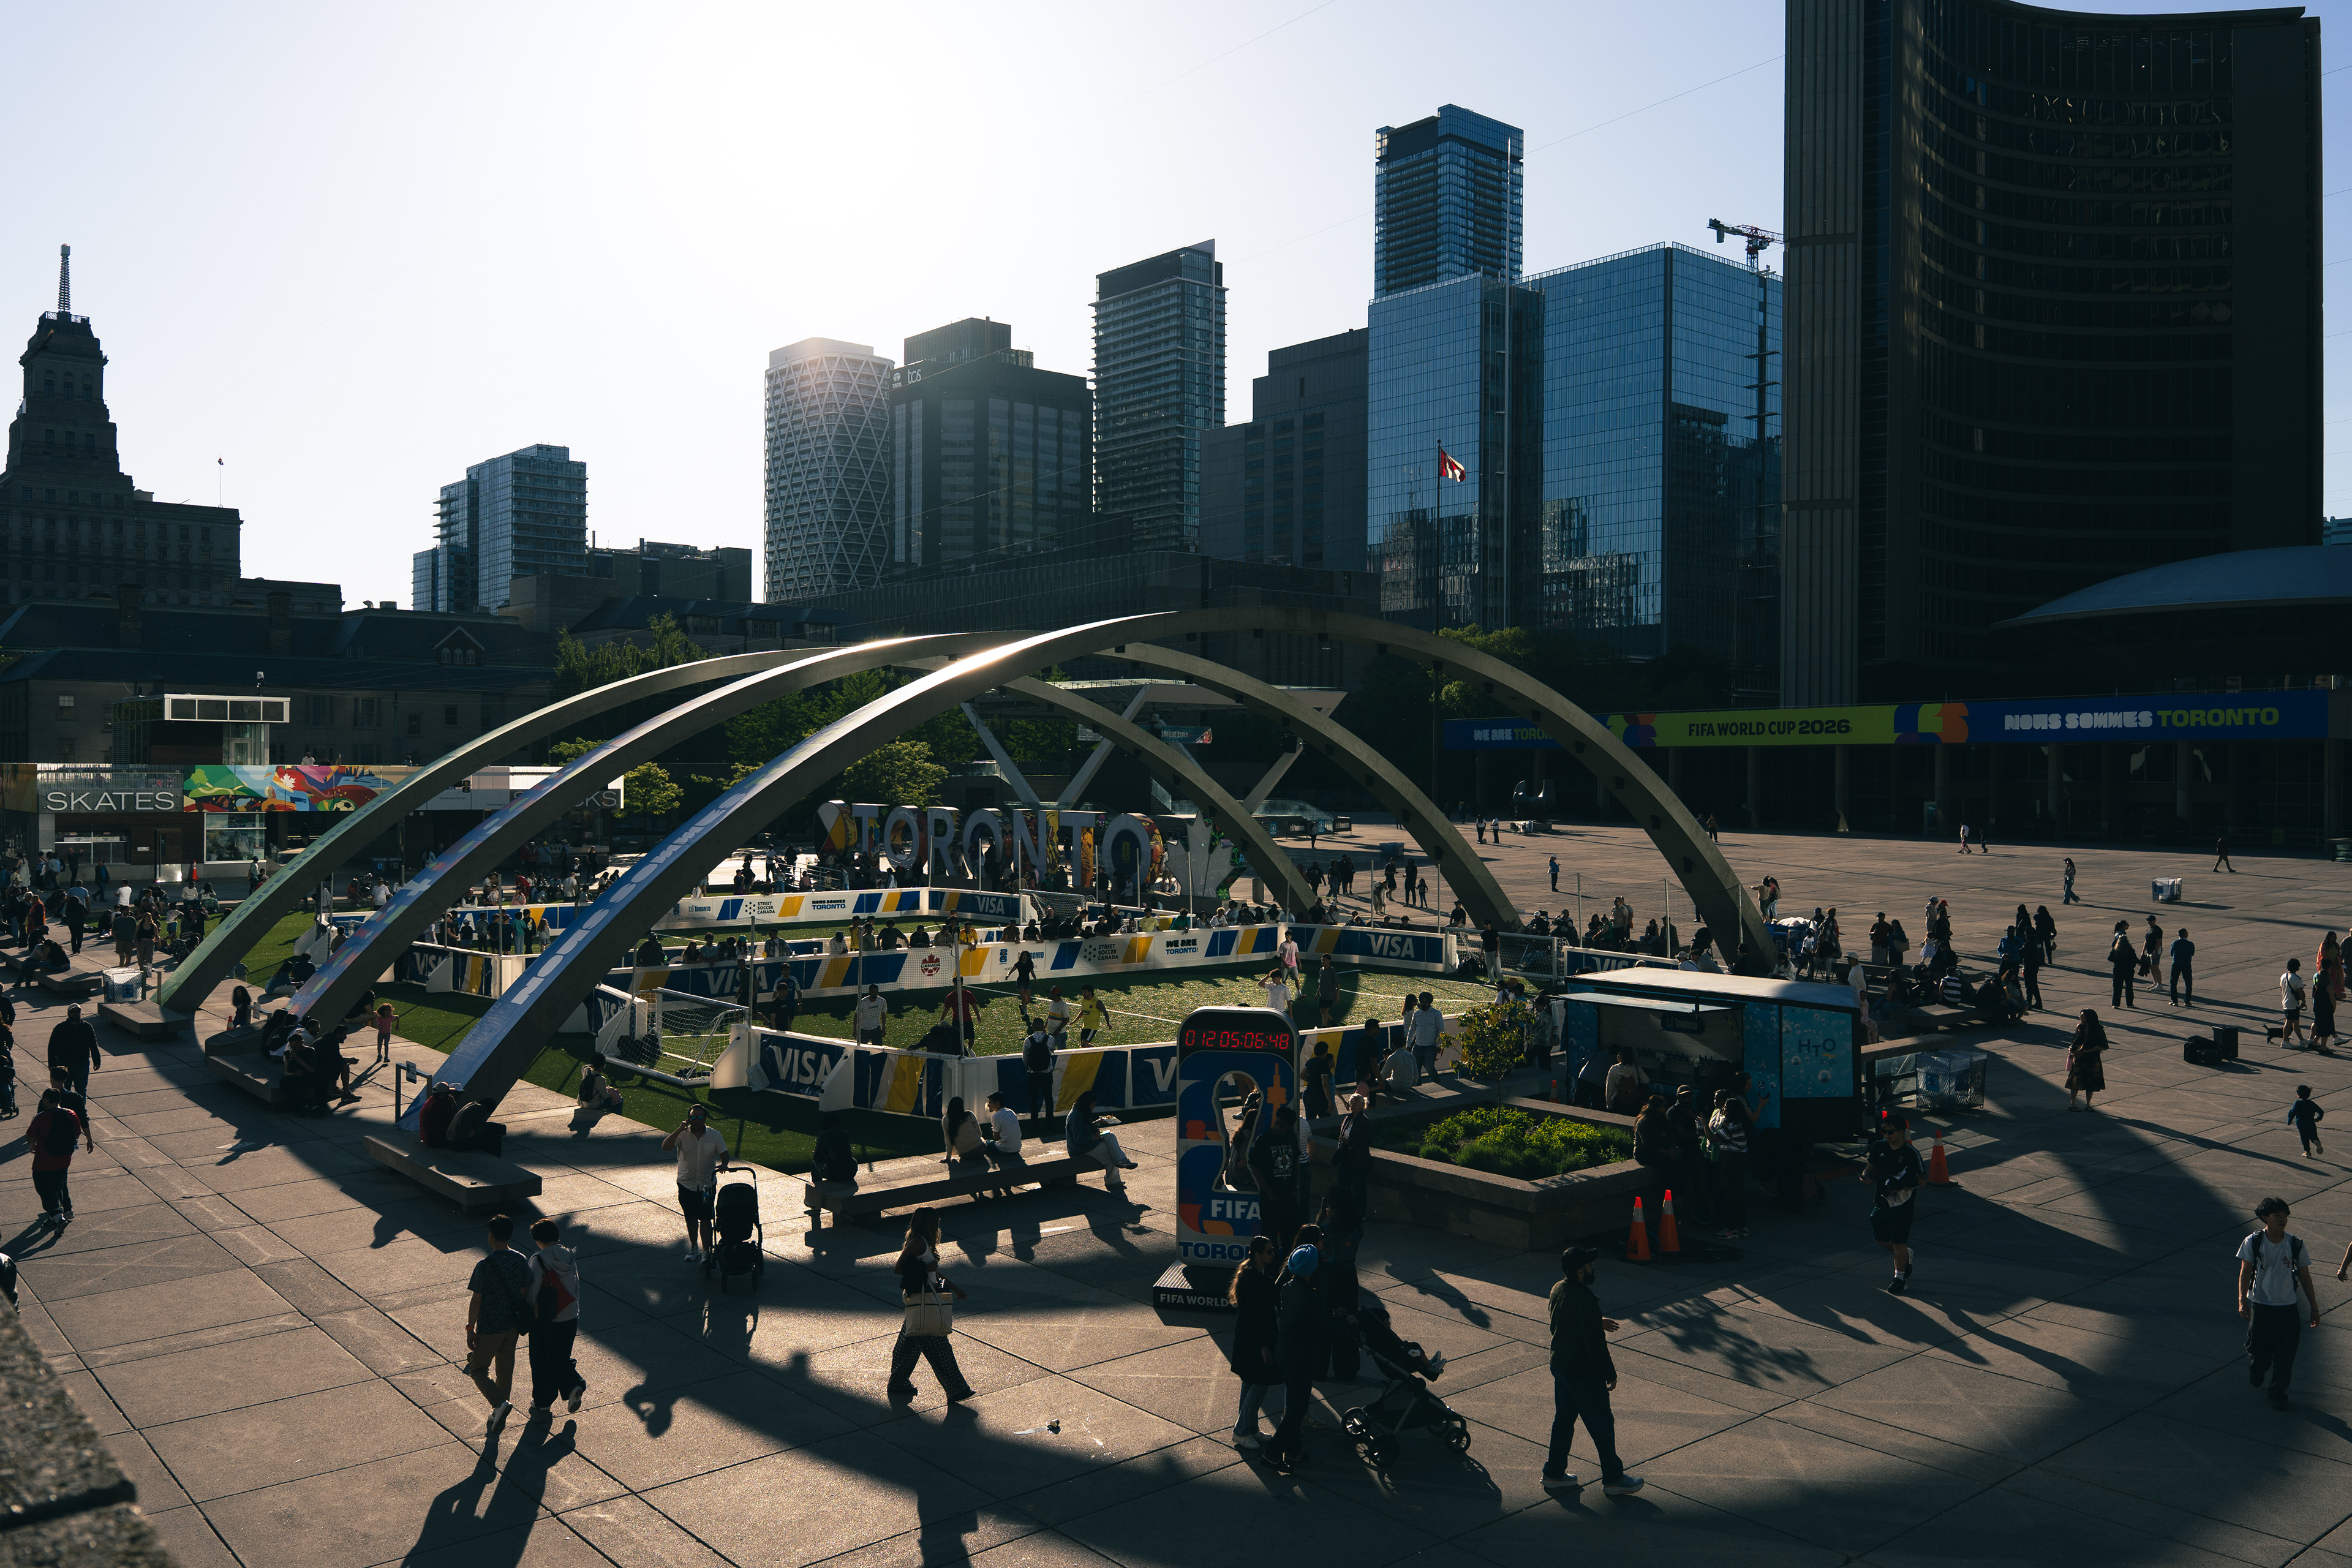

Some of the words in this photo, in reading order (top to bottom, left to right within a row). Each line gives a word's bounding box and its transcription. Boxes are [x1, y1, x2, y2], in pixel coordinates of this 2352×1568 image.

[907, 369, 922, 384] tcs
[1688, 723, 1716, 737] FIFA
[1717, 722, 1766, 736] WORLD
[1768, 720, 1796, 735] CUP
[1798, 718, 1850, 734] 2026
[2005, 714, 2062, 731] NOUS
[2065, 710, 2153, 729] SOMMES
[2157, 707, 2280, 728] TORONTO
[1474, 729, 1490, 741] WE
[1491, 728, 1512, 741] ARE
[46, 791, 175, 812] SKATES
[852, 803, 1162, 889] TORONTO
[224, 874, 287, 930] COUPE
[288, 849, 316, 871] DU
[318, 796, 388, 846] MONDE
[975, 895, 1005, 914] VISA
[1180, 938, 1197, 947] ARE
[1365, 933, 1415, 959] VISA
[1674, 1017, 1697, 1030] TORONTO
[1219, 1031, 1289, 1050] 05:06:48
[1798, 1038, 1836, 1057] HTO
[769, 1045, 833, 1086] VISA
[1270, 1144, 1294, 1158] FIFA
[1211, 1199, 1262, 1220] FIFA
[1159, 1293, 1185, 1305] FIFA
[1186, 1295, 1230, 1308] WORLD
